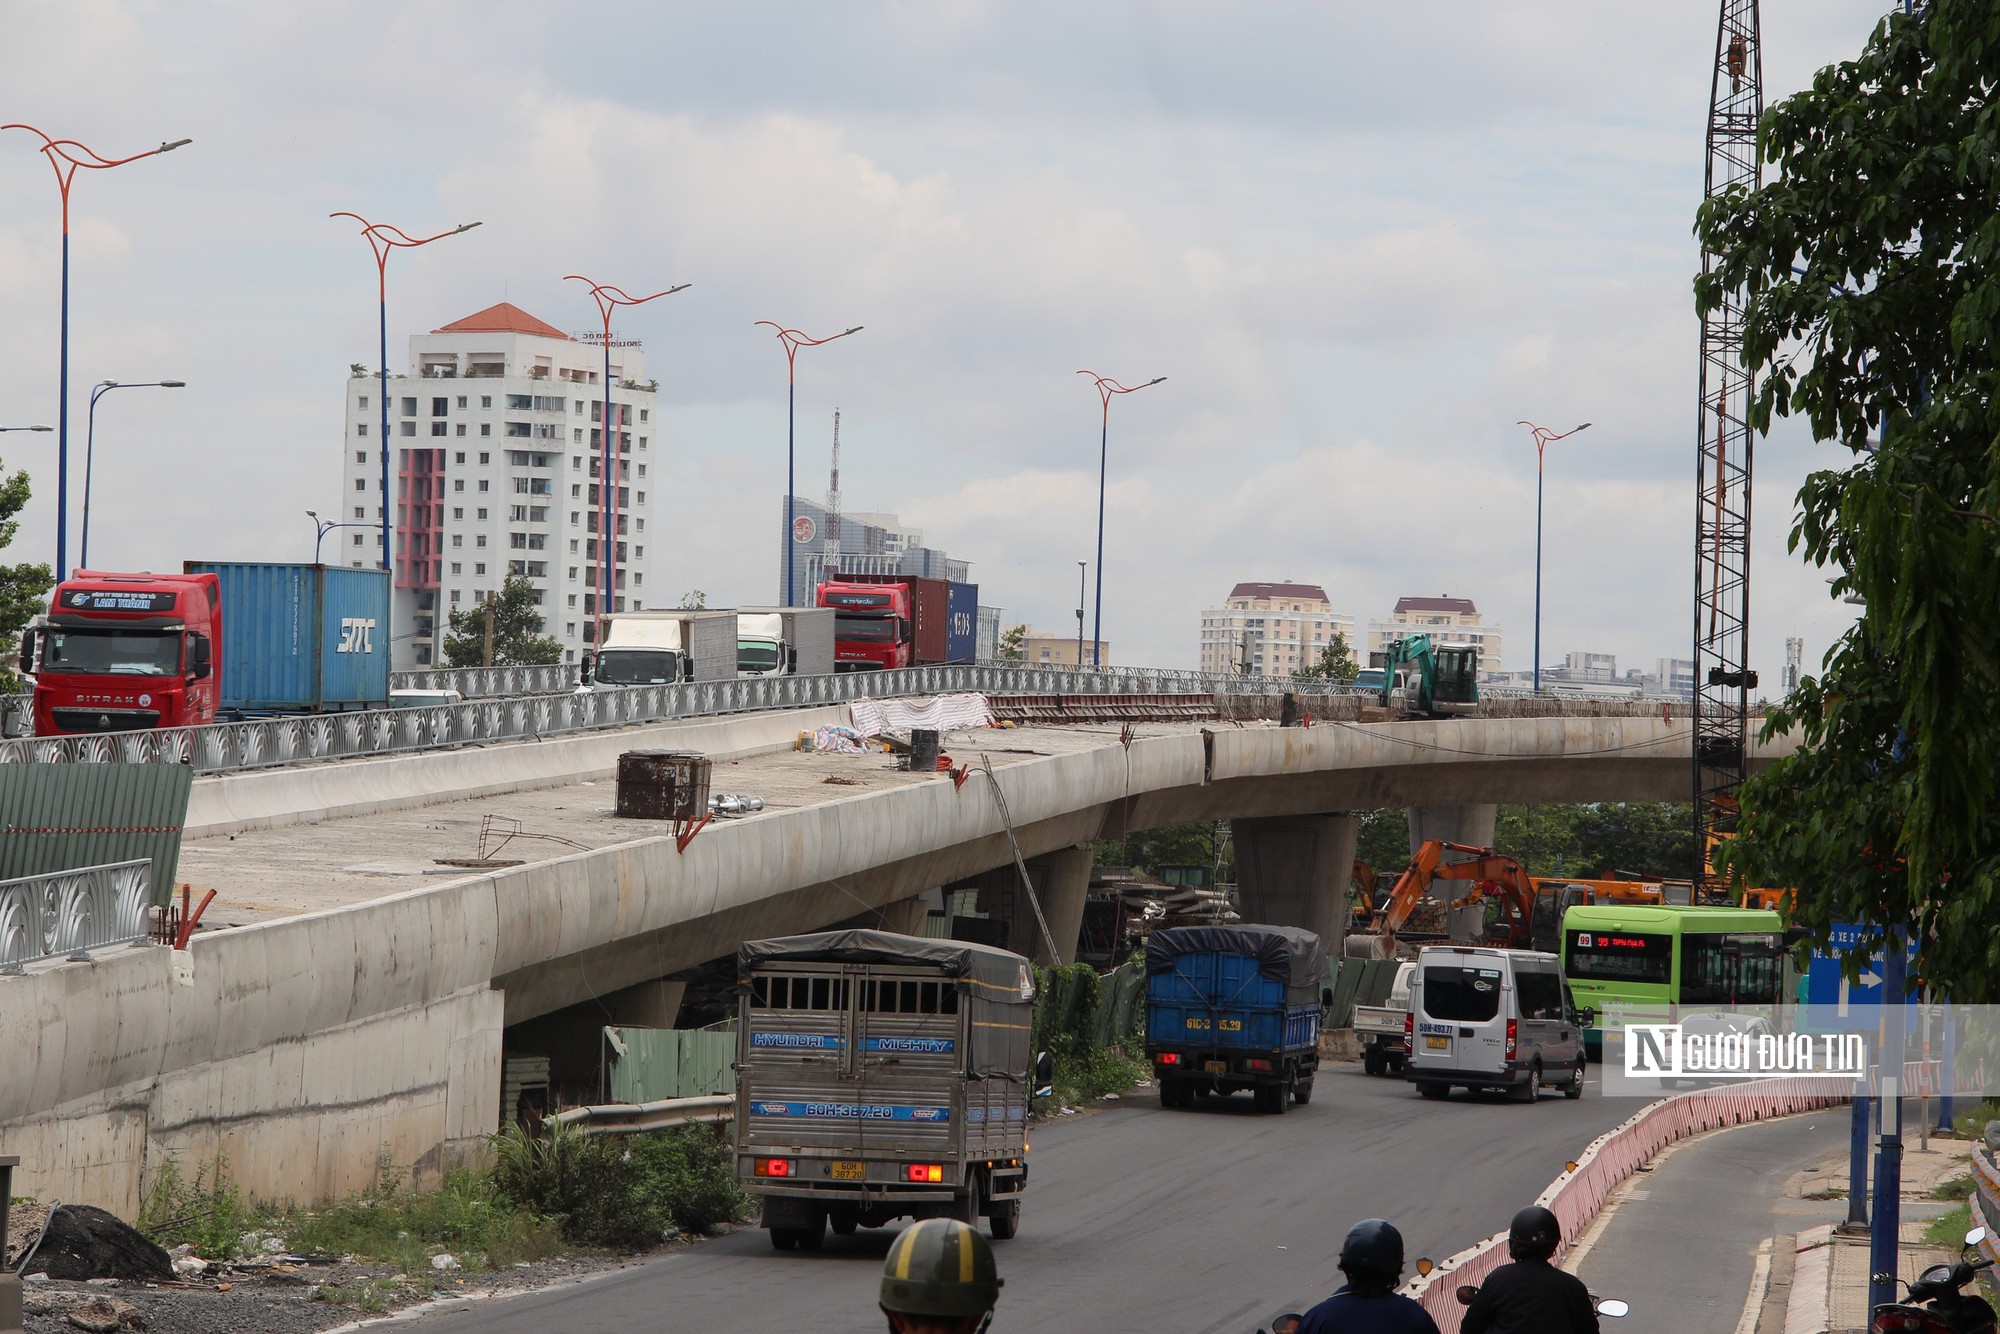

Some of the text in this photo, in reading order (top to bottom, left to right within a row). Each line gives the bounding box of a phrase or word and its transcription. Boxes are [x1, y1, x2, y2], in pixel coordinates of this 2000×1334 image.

[76, 694, 134, 703] SITRAK
[1580, 936, 1590, 945] 99
[1838, 931, 1847, 942] XE
[1419, 1023, 1453, 1034] 50H-493.77
[754, 1033, 825, 1048] HYUNDAI
[878, 1037, 948, 1052] MIGHTY
[841, 1162, 857, 1170] 60H
[835, 1170, 862, 1179] 387.20
